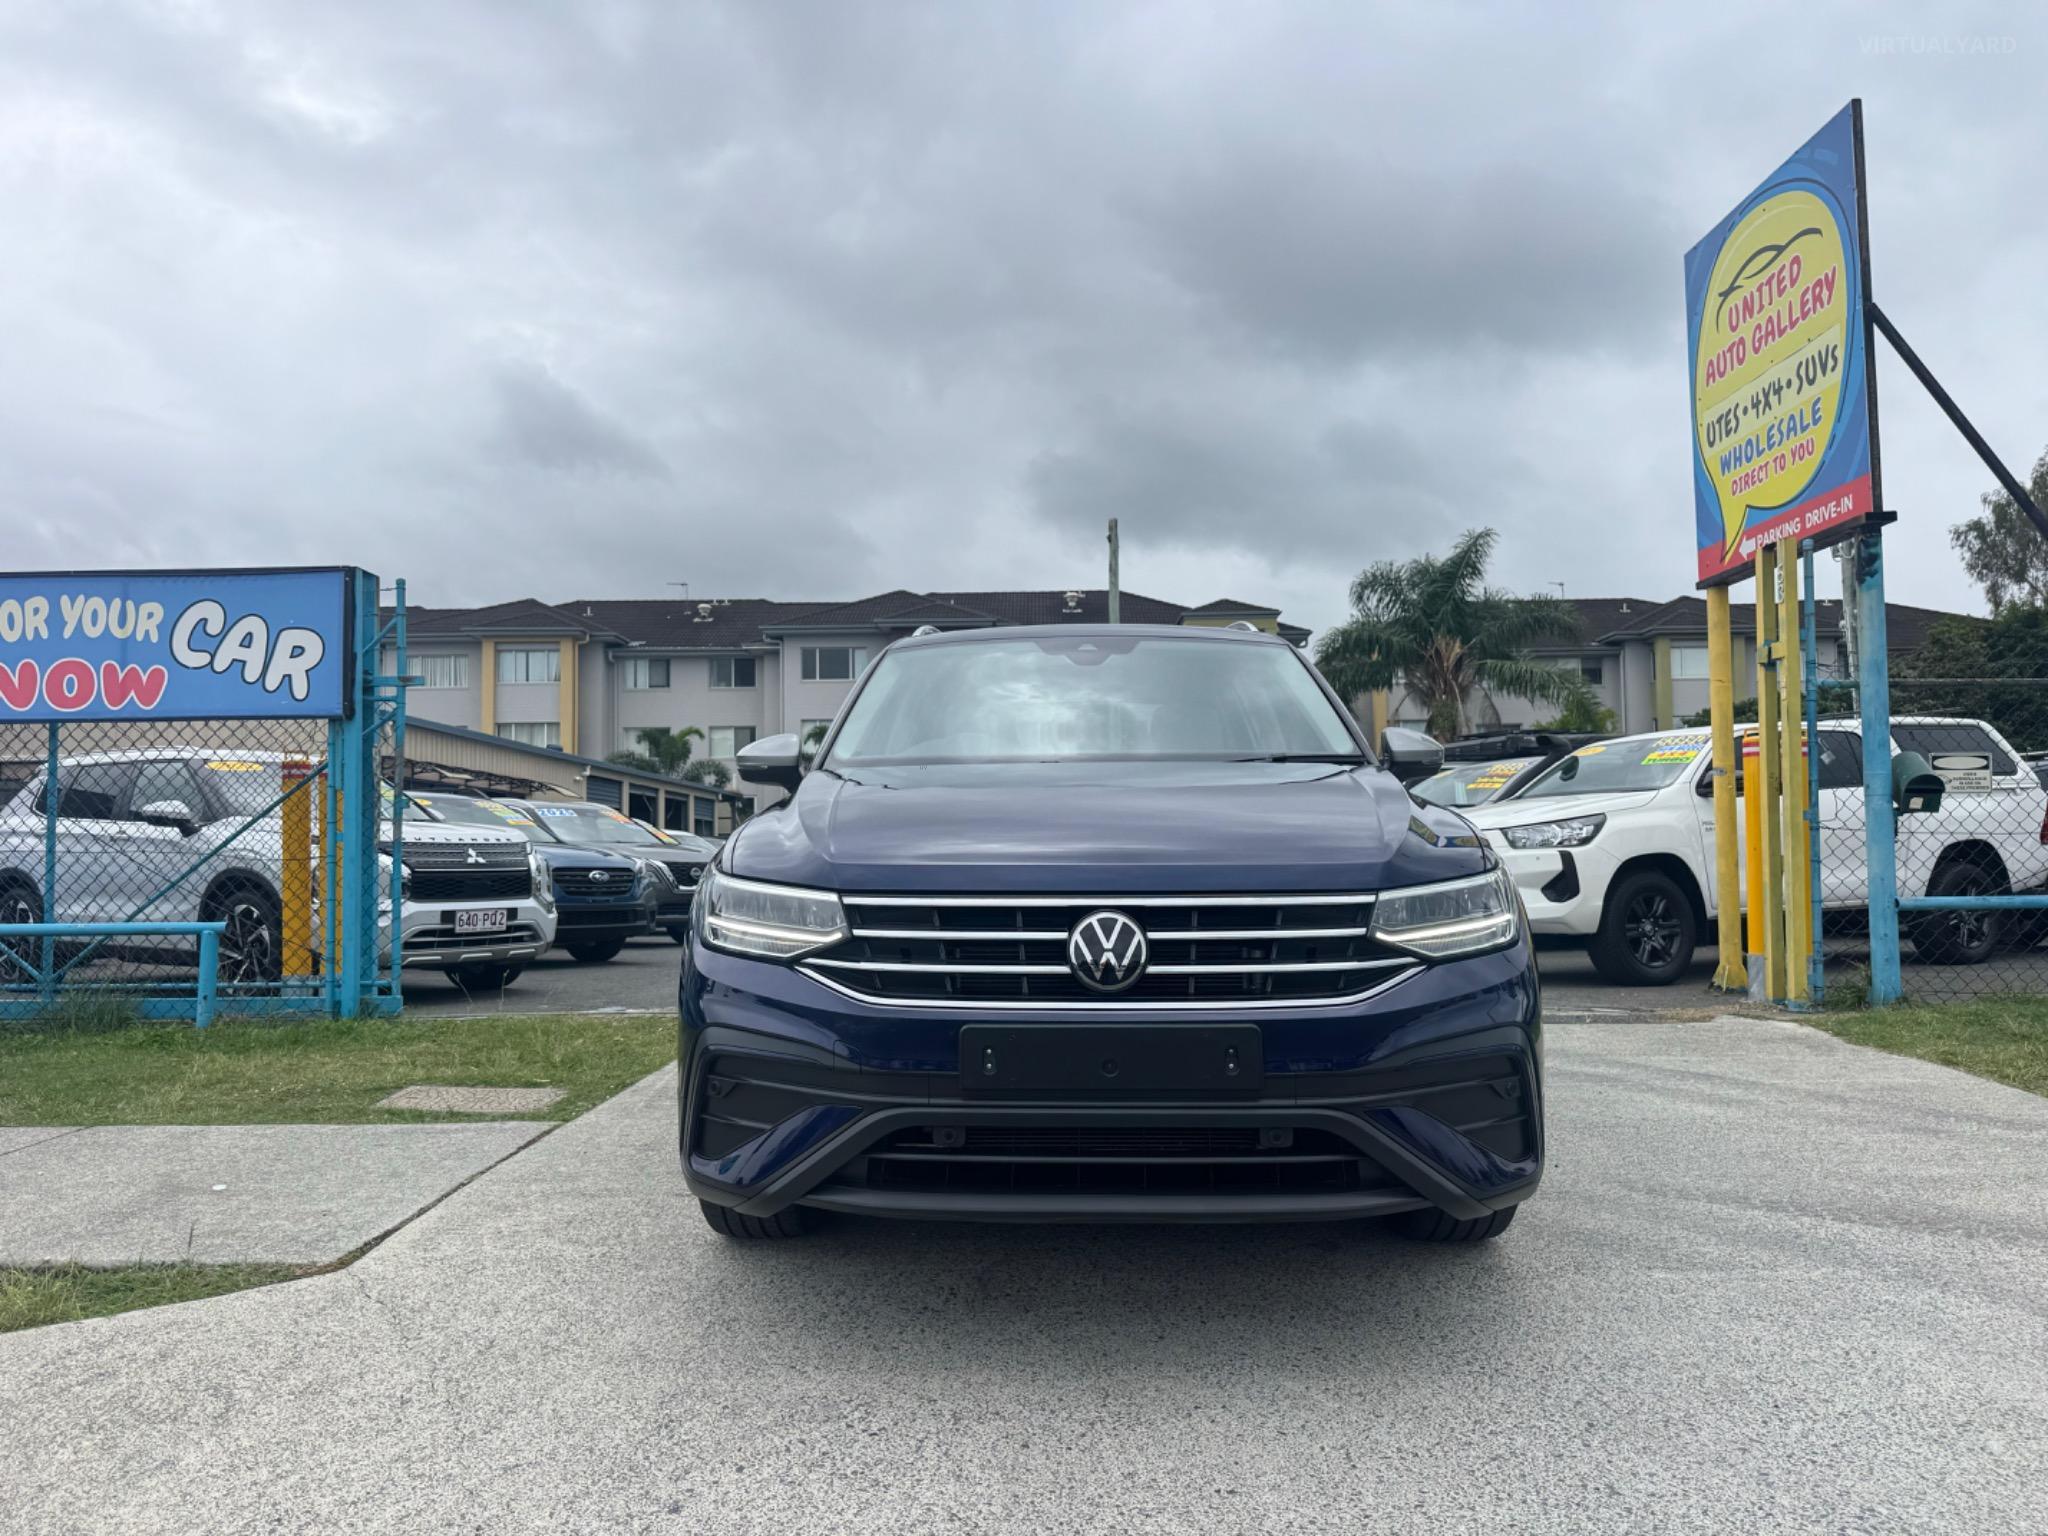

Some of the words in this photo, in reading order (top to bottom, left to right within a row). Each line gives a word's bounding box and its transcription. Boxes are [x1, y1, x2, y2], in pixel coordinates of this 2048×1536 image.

[1705, 335, 1746, 388] AUTO
[1752, 265, 1836, 355] GALLERY
[1728, 254, 1802, 333] UNITED
[1706, 402, 1739, 448] UTES
[1720, 397, 1822, 477] WHOLESALE
[1731, 460, 1769, 496] DIRECT
[1772, 453, 1786, 474] TO
[1790, 437, 1815, 466] YOU
[1755, 517, 1801, 548] PARKING
[1805, 494, 1853, 529] DRIVE-IN
[0, 596, 49, 642] OR
[59, 594, 164, 643] YOUR
[169, 598, 325, 702] CAR
[0, 657, 168, 712] NOW
